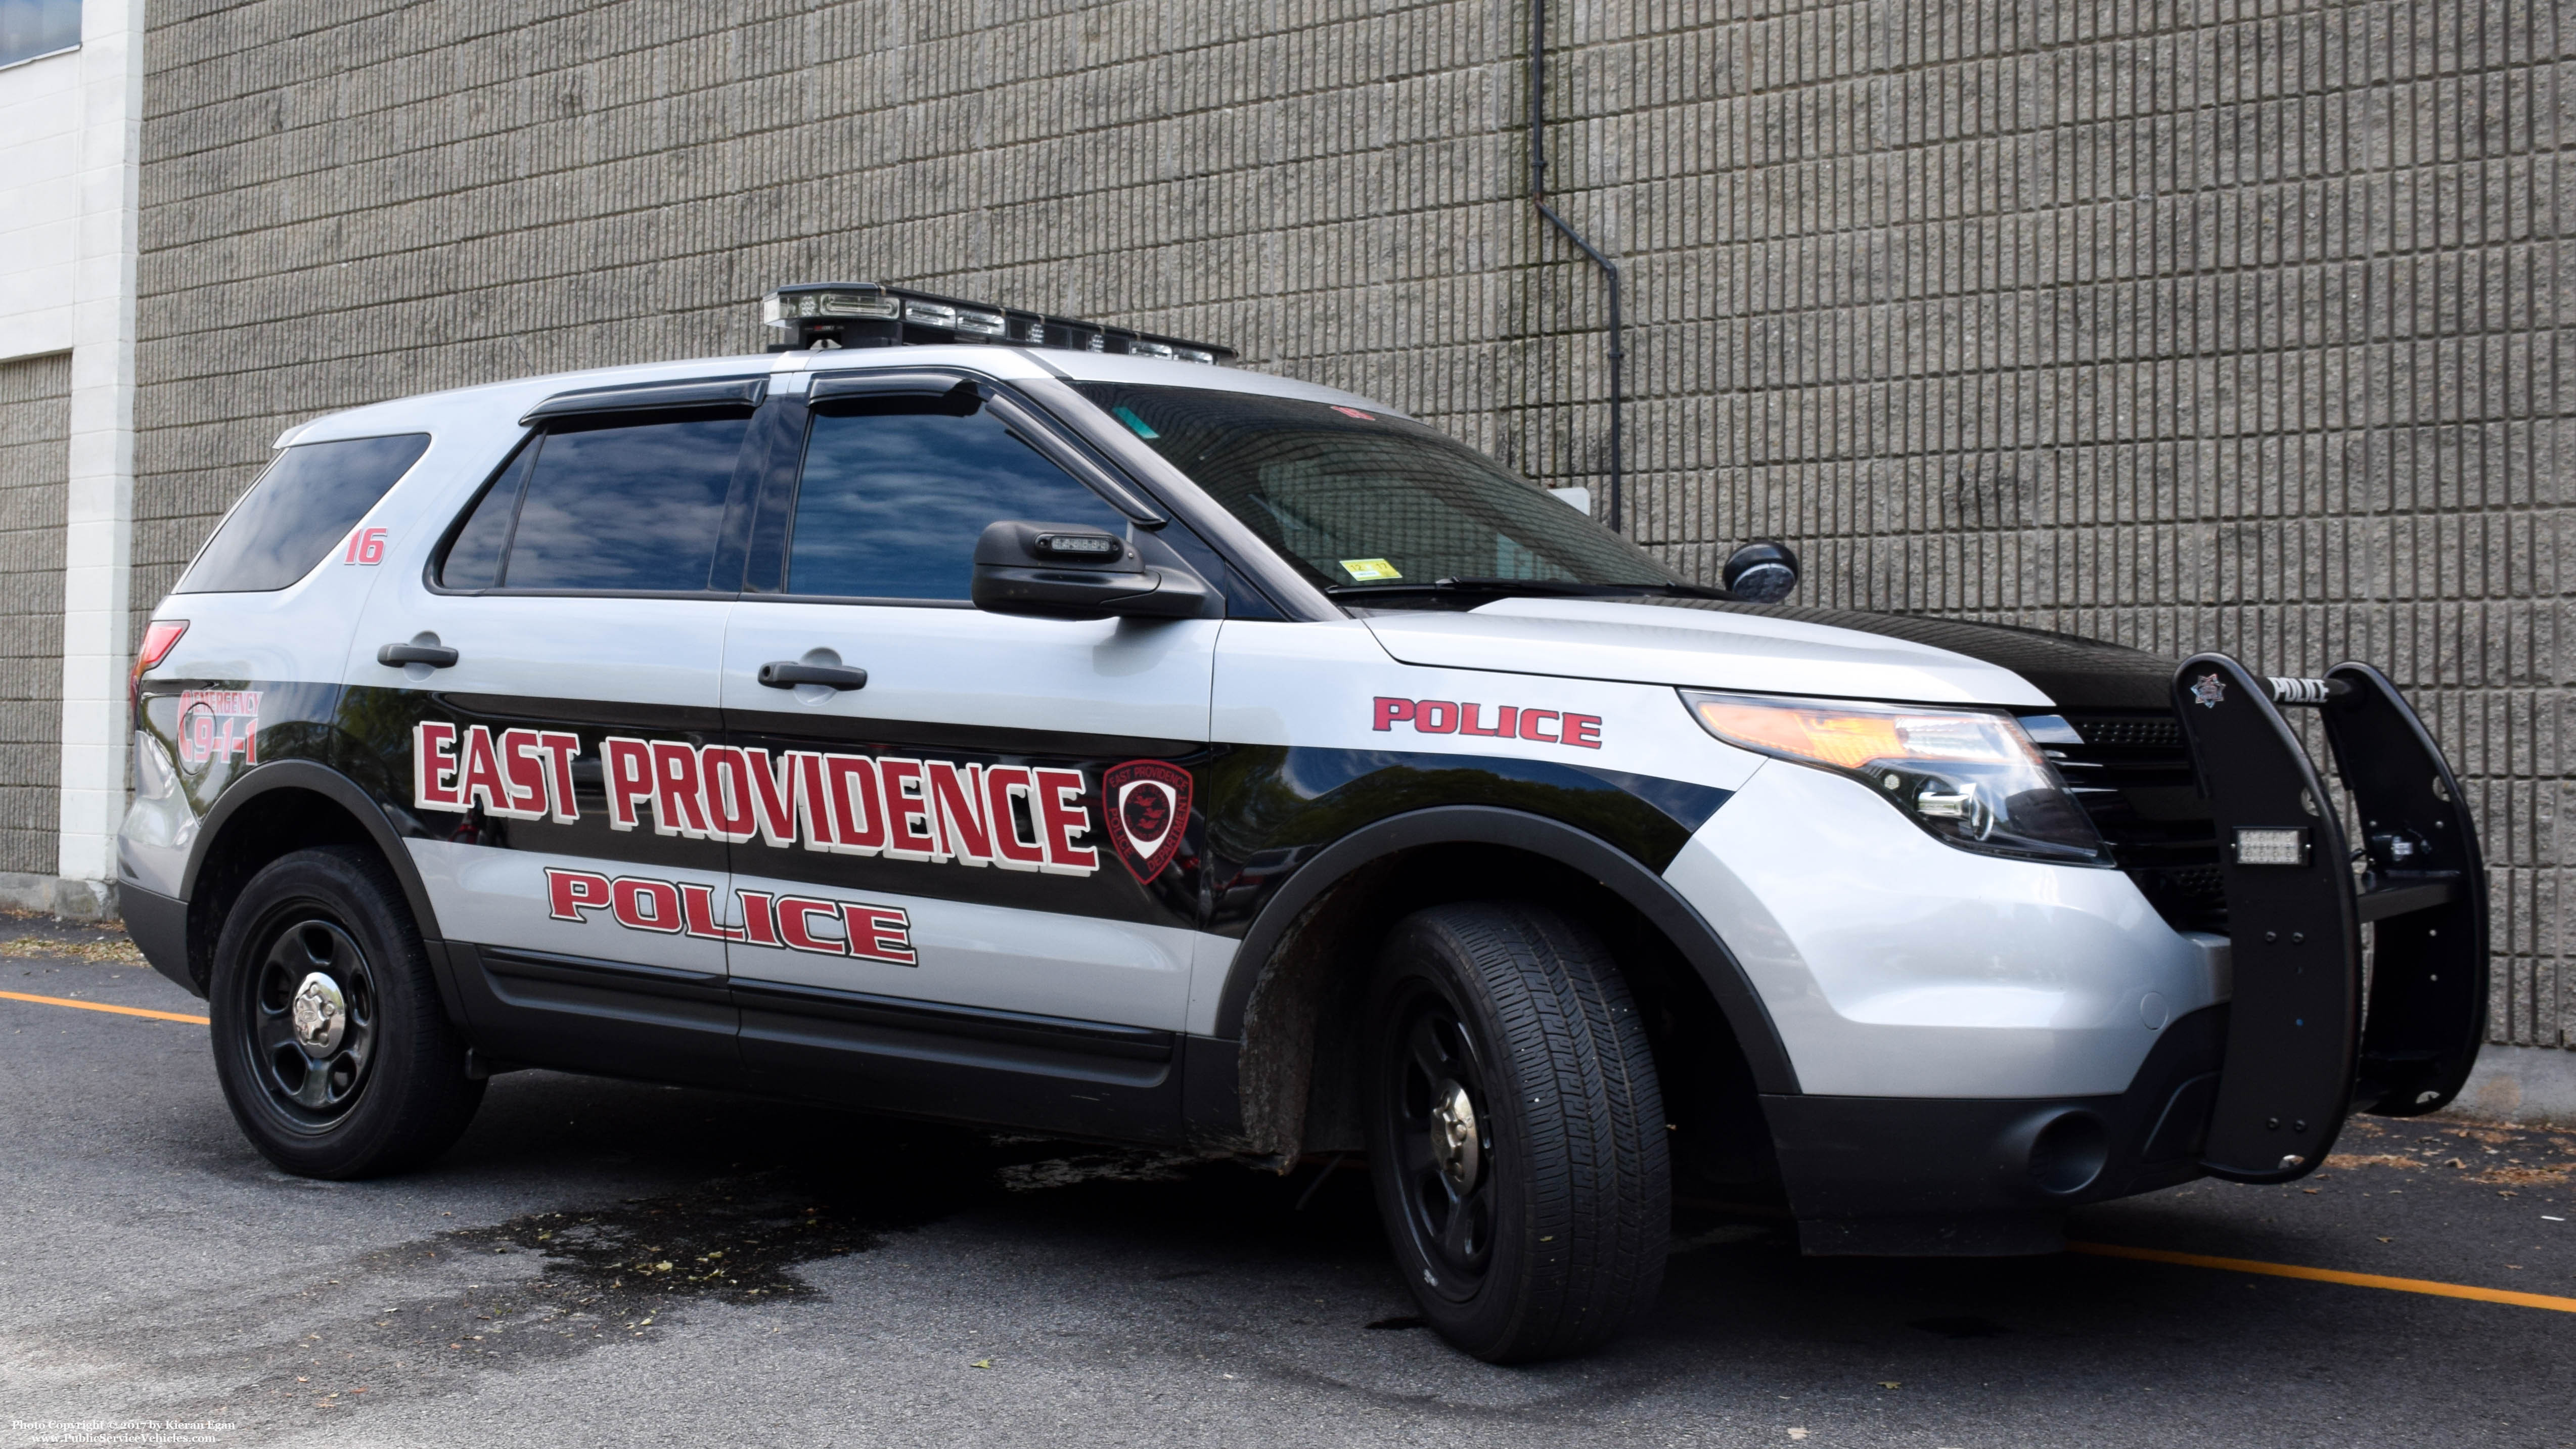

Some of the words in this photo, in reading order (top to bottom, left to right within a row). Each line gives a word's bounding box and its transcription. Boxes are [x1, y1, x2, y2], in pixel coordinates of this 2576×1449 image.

[344, 527, 388, 565] 16
[193, 691, 262, 716] EMERGENCY
[2266, 677, 2329, 703] POLICE
[194, 716, 258, 765] 9-1-1
[1373, 697, 1602, 749] POLICE
[414, 721, 580, 825] EAST
[600, 736, 1099, 877] PROVIDENCE
[1109, 768, 1131, 788] EAST
[1135, 766, 1188, 791] PROVIDENCE
[1109, 808, 1134, 857] POLICE
[1147, 795, 1187, 872] DEPARTMENT
[544, 867, 918, 968] POLICE
